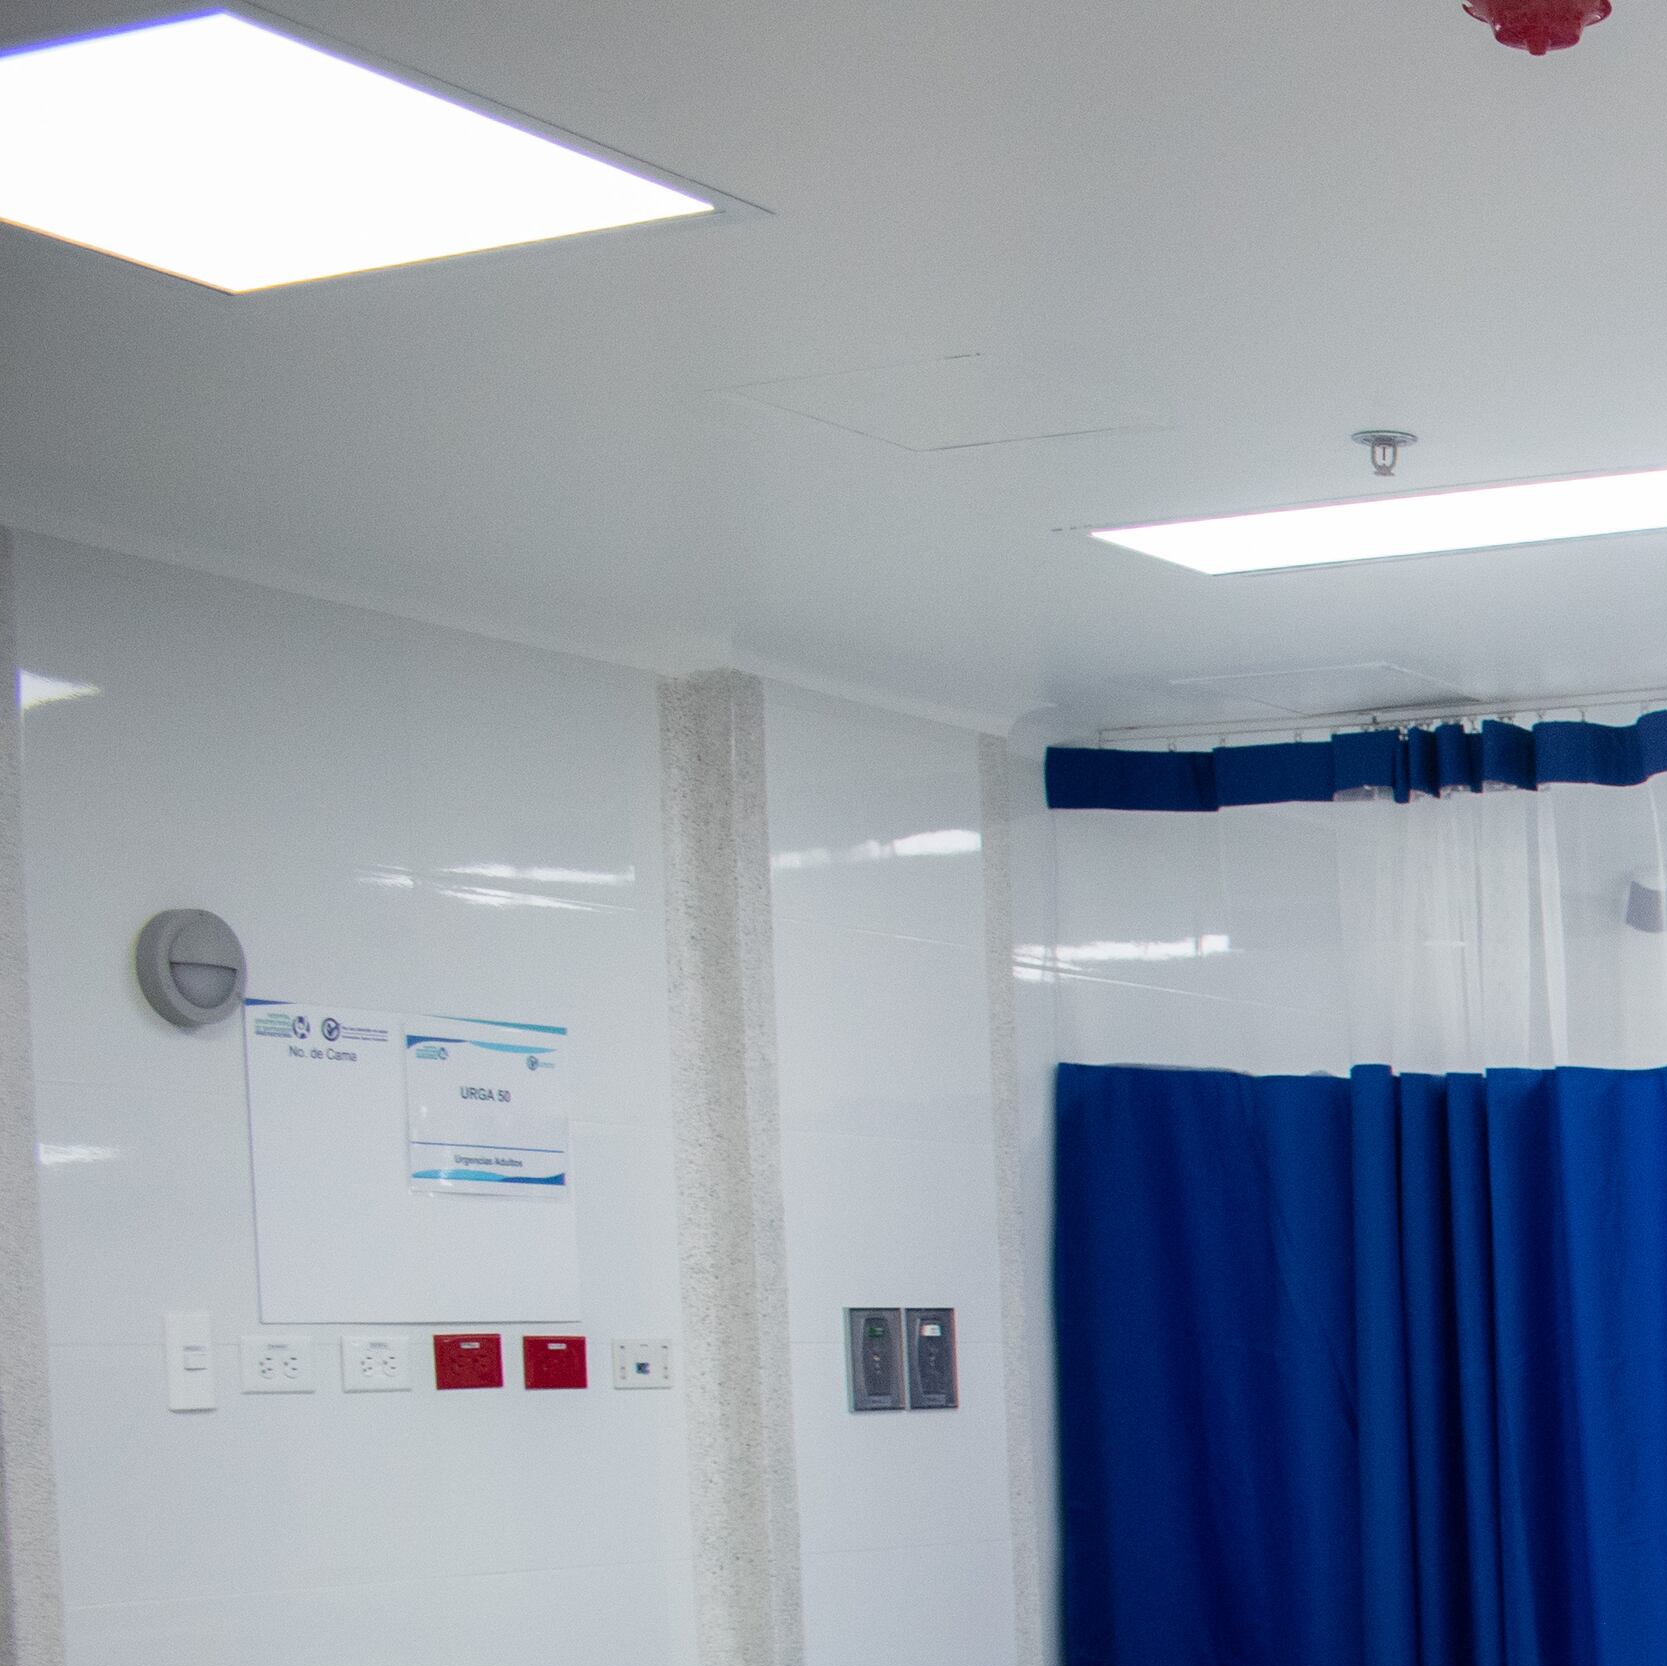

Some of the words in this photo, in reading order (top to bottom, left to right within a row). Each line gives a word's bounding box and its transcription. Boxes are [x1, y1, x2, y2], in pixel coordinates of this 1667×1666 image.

[289, 1045, 307, 1058] No.
[310, 1047, 324, 1060] de
[326, 1048, 358, 1062] Cama
[460, 1086, 495, 1101] URGA
